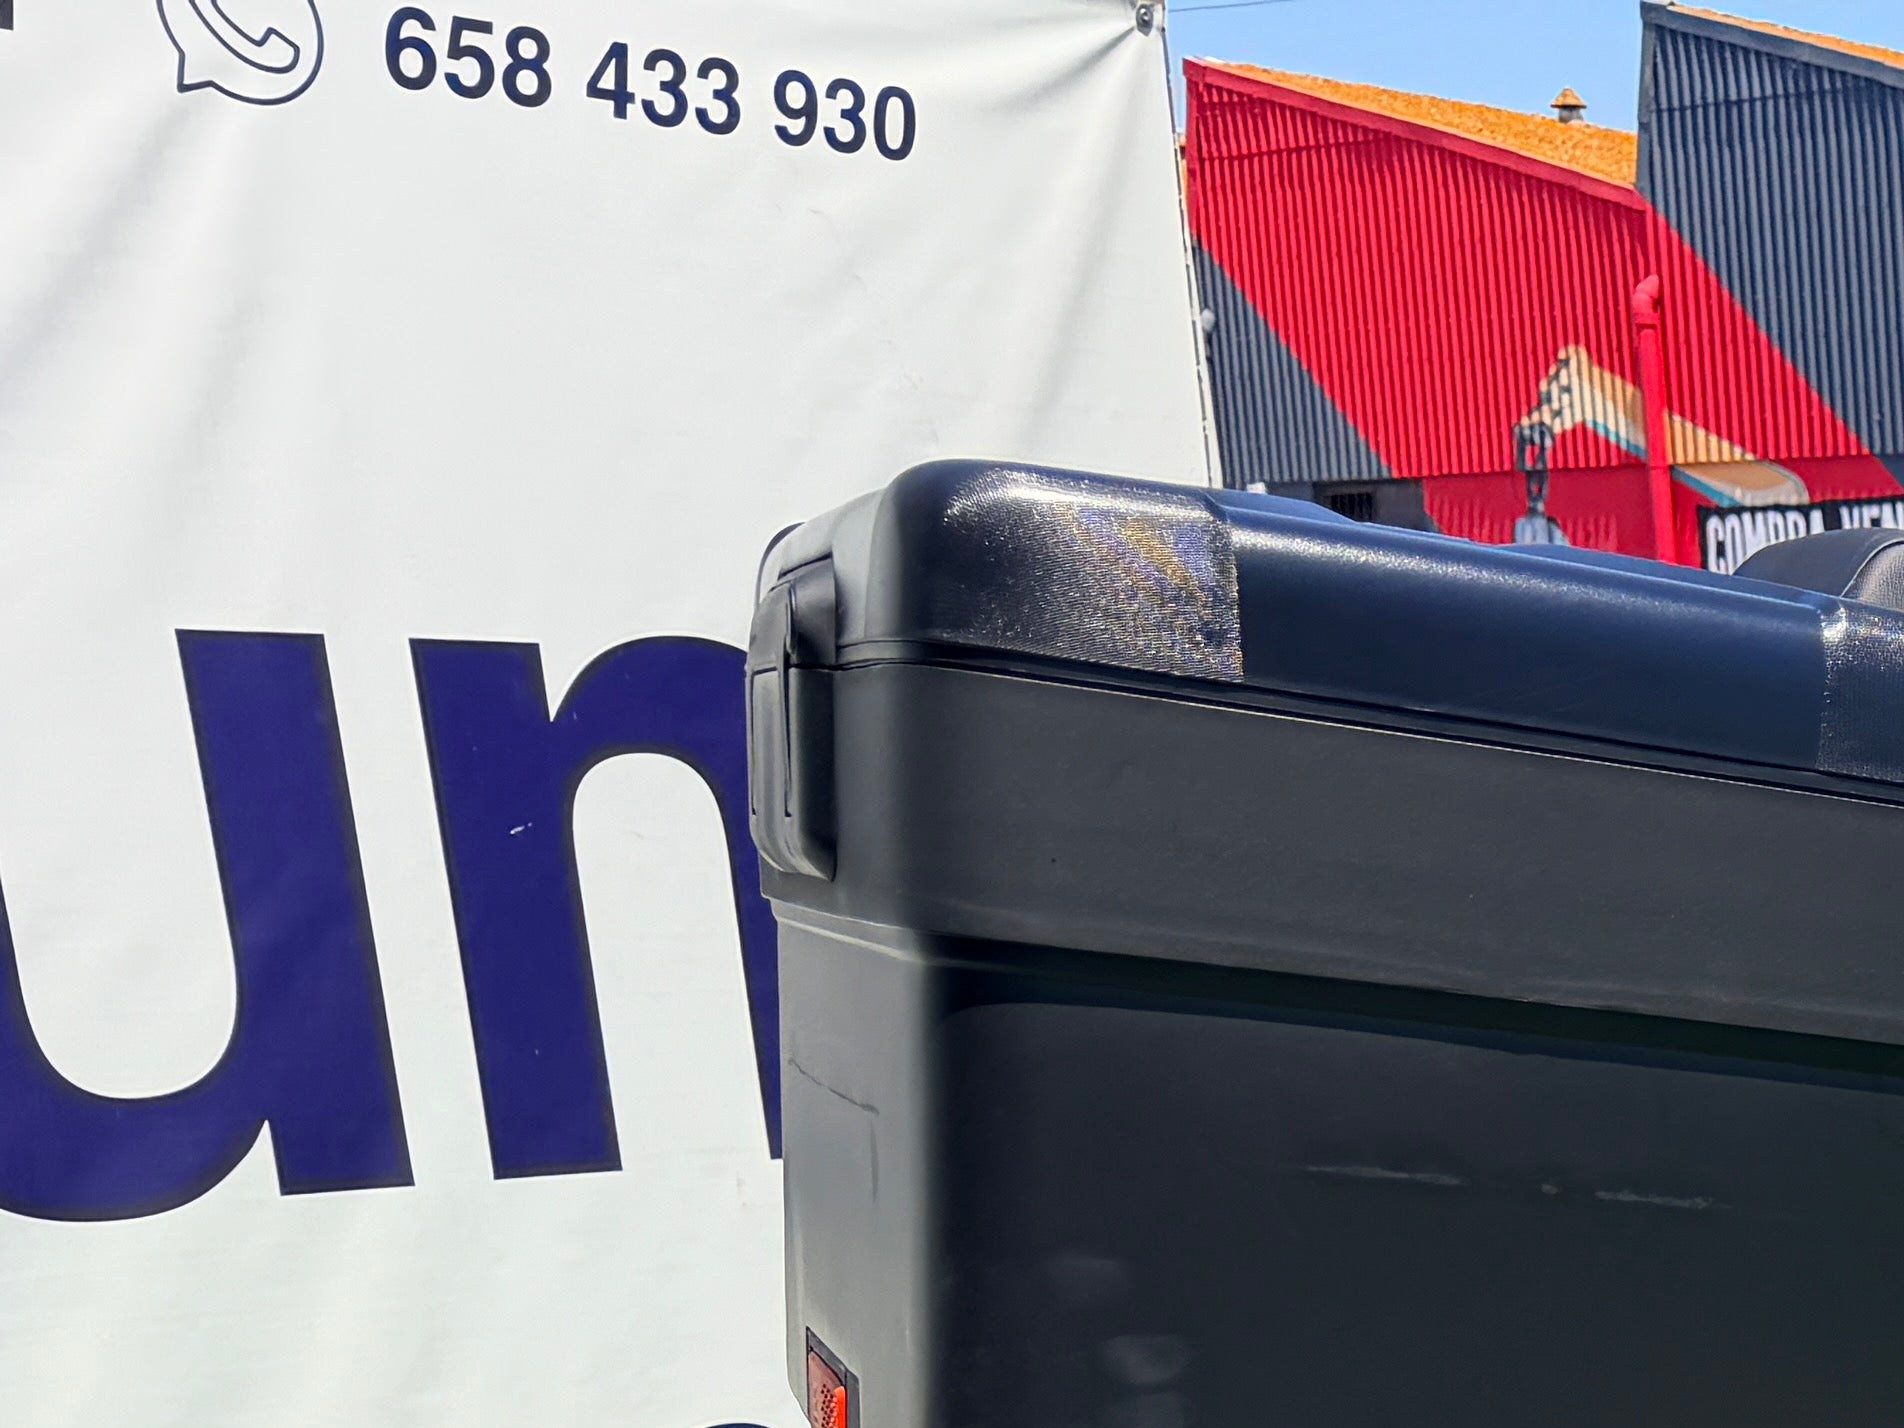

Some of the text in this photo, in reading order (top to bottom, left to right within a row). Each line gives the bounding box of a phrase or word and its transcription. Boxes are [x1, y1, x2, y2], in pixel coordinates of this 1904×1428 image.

[385, 9, 917, 161] 658 433 930
